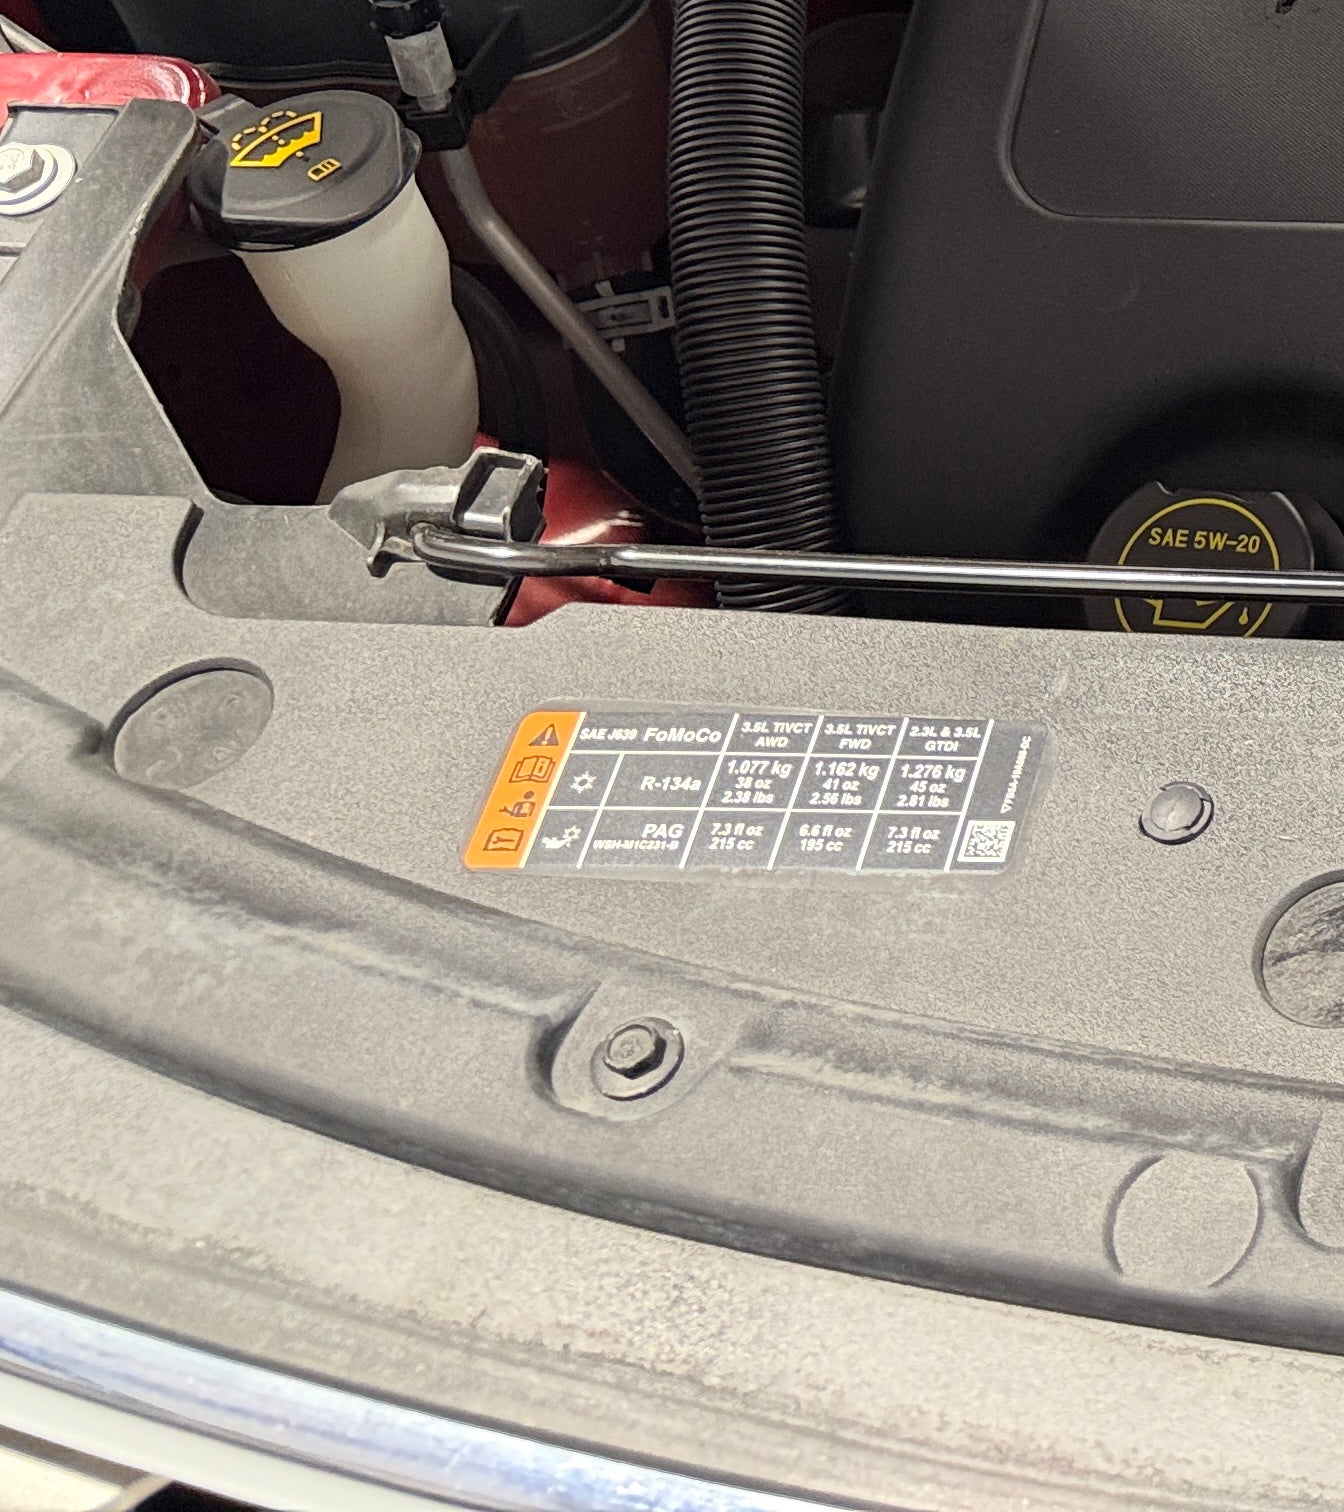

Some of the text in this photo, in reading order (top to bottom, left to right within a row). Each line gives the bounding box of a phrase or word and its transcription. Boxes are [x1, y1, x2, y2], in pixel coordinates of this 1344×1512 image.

[1149, 527, 1262, 554] SAE 5W-20
[741, 721, 770, 733] 3.5L
[824, 723, 853, 735] 3.5L
[909, 726, 982, 739] 2.3L & 3.5L
[580, 727, 722, 742] SAE J639 FoMoCo
[754, 737, 789, 748] AWD
[839, 738, 872, 750] FWD
[727, 760, 793, 778] 1.077 kg
[815, 761, 880, 780] 1.162 kg
[901, 763, 966, 783] 1.276 kg
[640, 775, 702, 790] R-134a
[735, 776, 773, 789] 38 oz
[822, 777, 860, 791] 41 oz
[910, 781, 947, 793] 45 oz
[721, 791, 775, 804] 2.38 lbs
[809, 792, 862, 805] 2.56 lbs
[896, 794, 950, 808] 2.81 lbs
[642, 823, 686, 838] PAG
[711, 822, 764, 836] 7.3 fl oz
[799, 824, 853, 838] 6.6 fl oz
[887, 826, 941, 840] 7.3 fl oz
[709, 837, 755, 851] 215 cc
[800, 839, 844, 852] 195 cc
[886, 840, 932, 854] 215 cc
